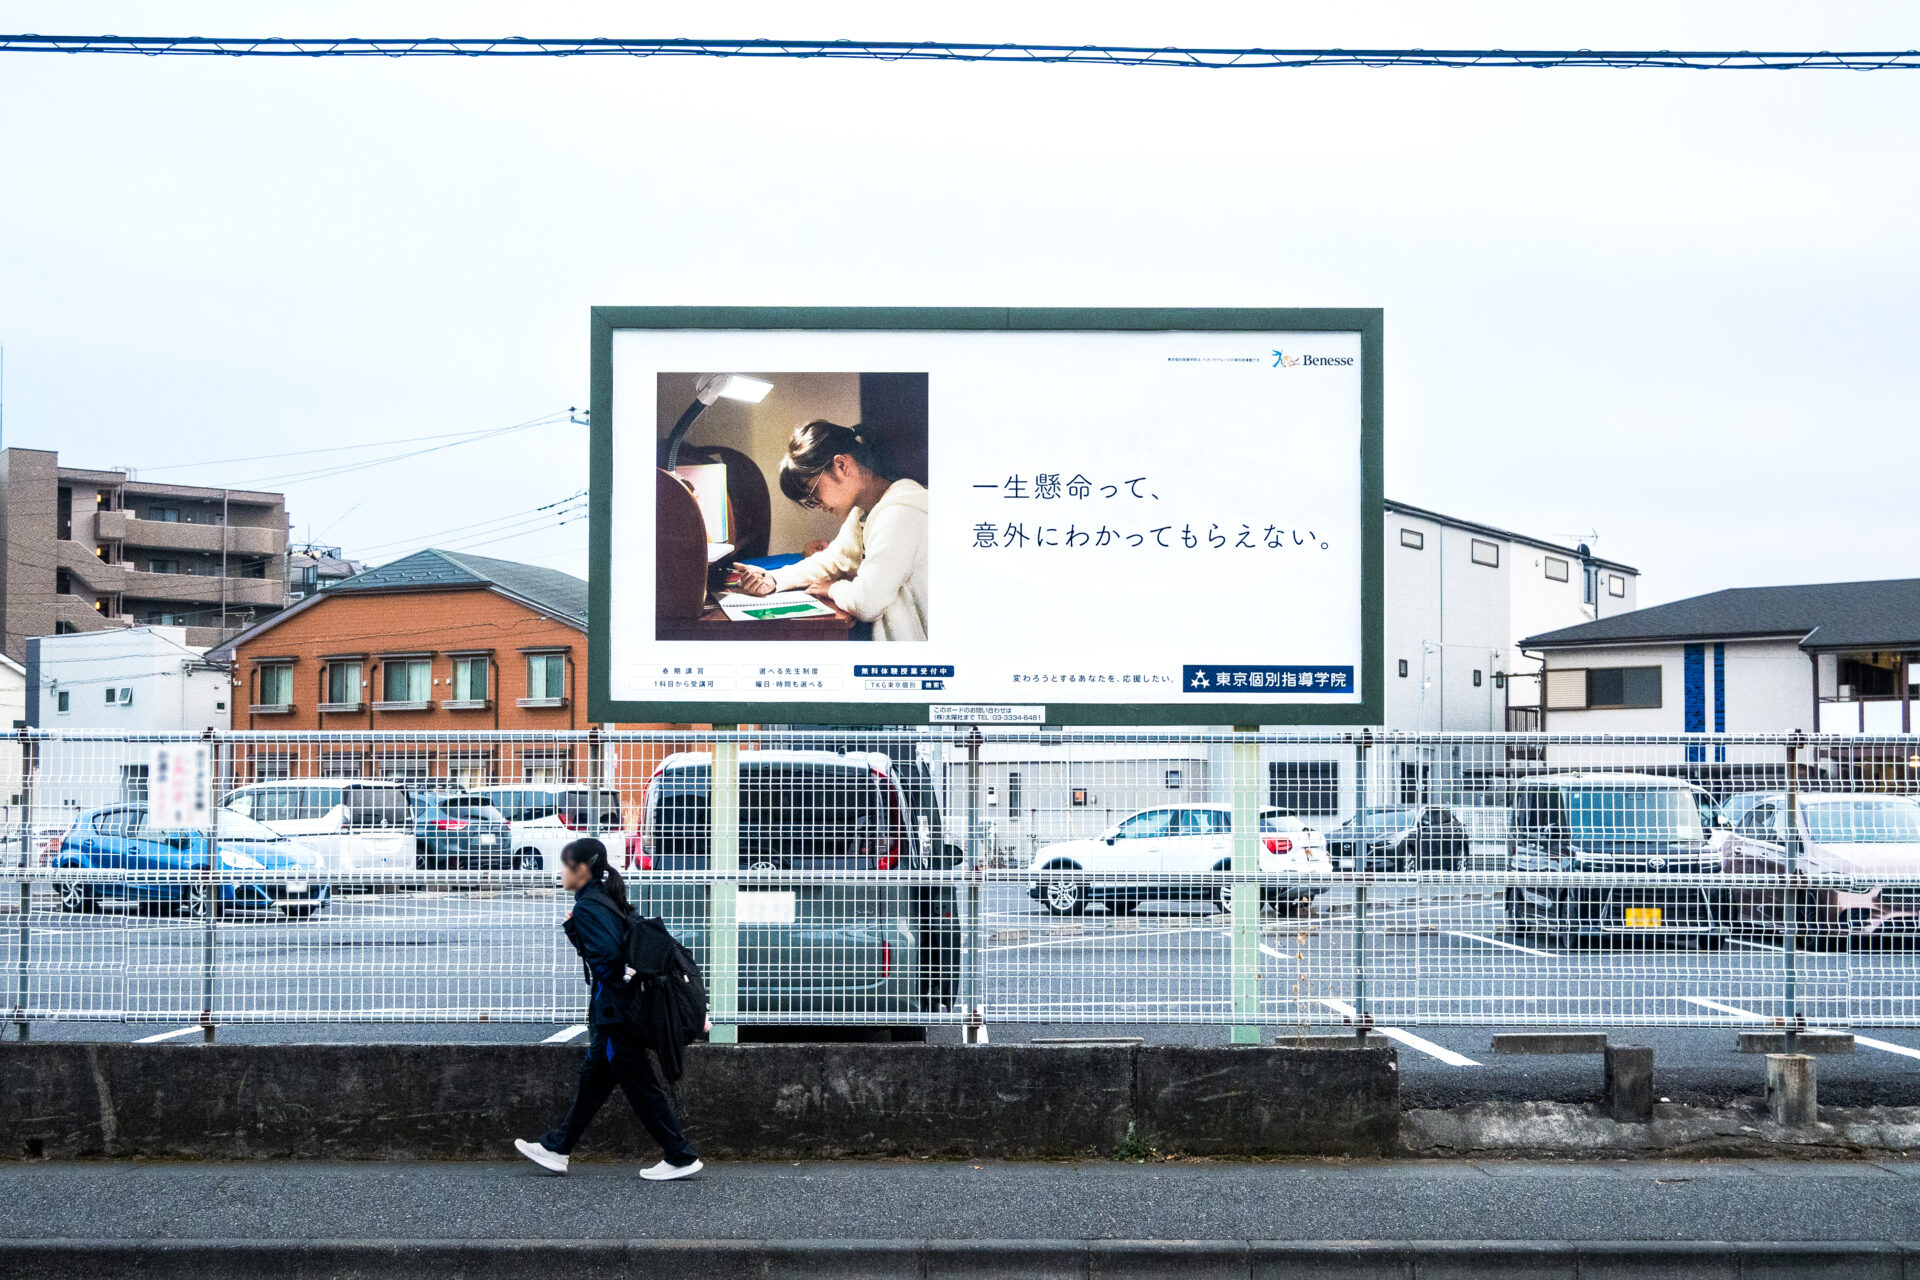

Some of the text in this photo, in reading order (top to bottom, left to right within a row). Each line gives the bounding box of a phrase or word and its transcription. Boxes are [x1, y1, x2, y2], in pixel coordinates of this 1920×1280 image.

[1303, 354, 1354, 366] Benesse
[972, 473, 1159, 501] 一生懸命って、
[972, 521, 1330, 550] 意外にわかってもらえない。
[1013, 674, 1174, 684] 変わろうとするあなたを、応援したい。
[1215, 671, 1347, 687] 東京個別指導学院
